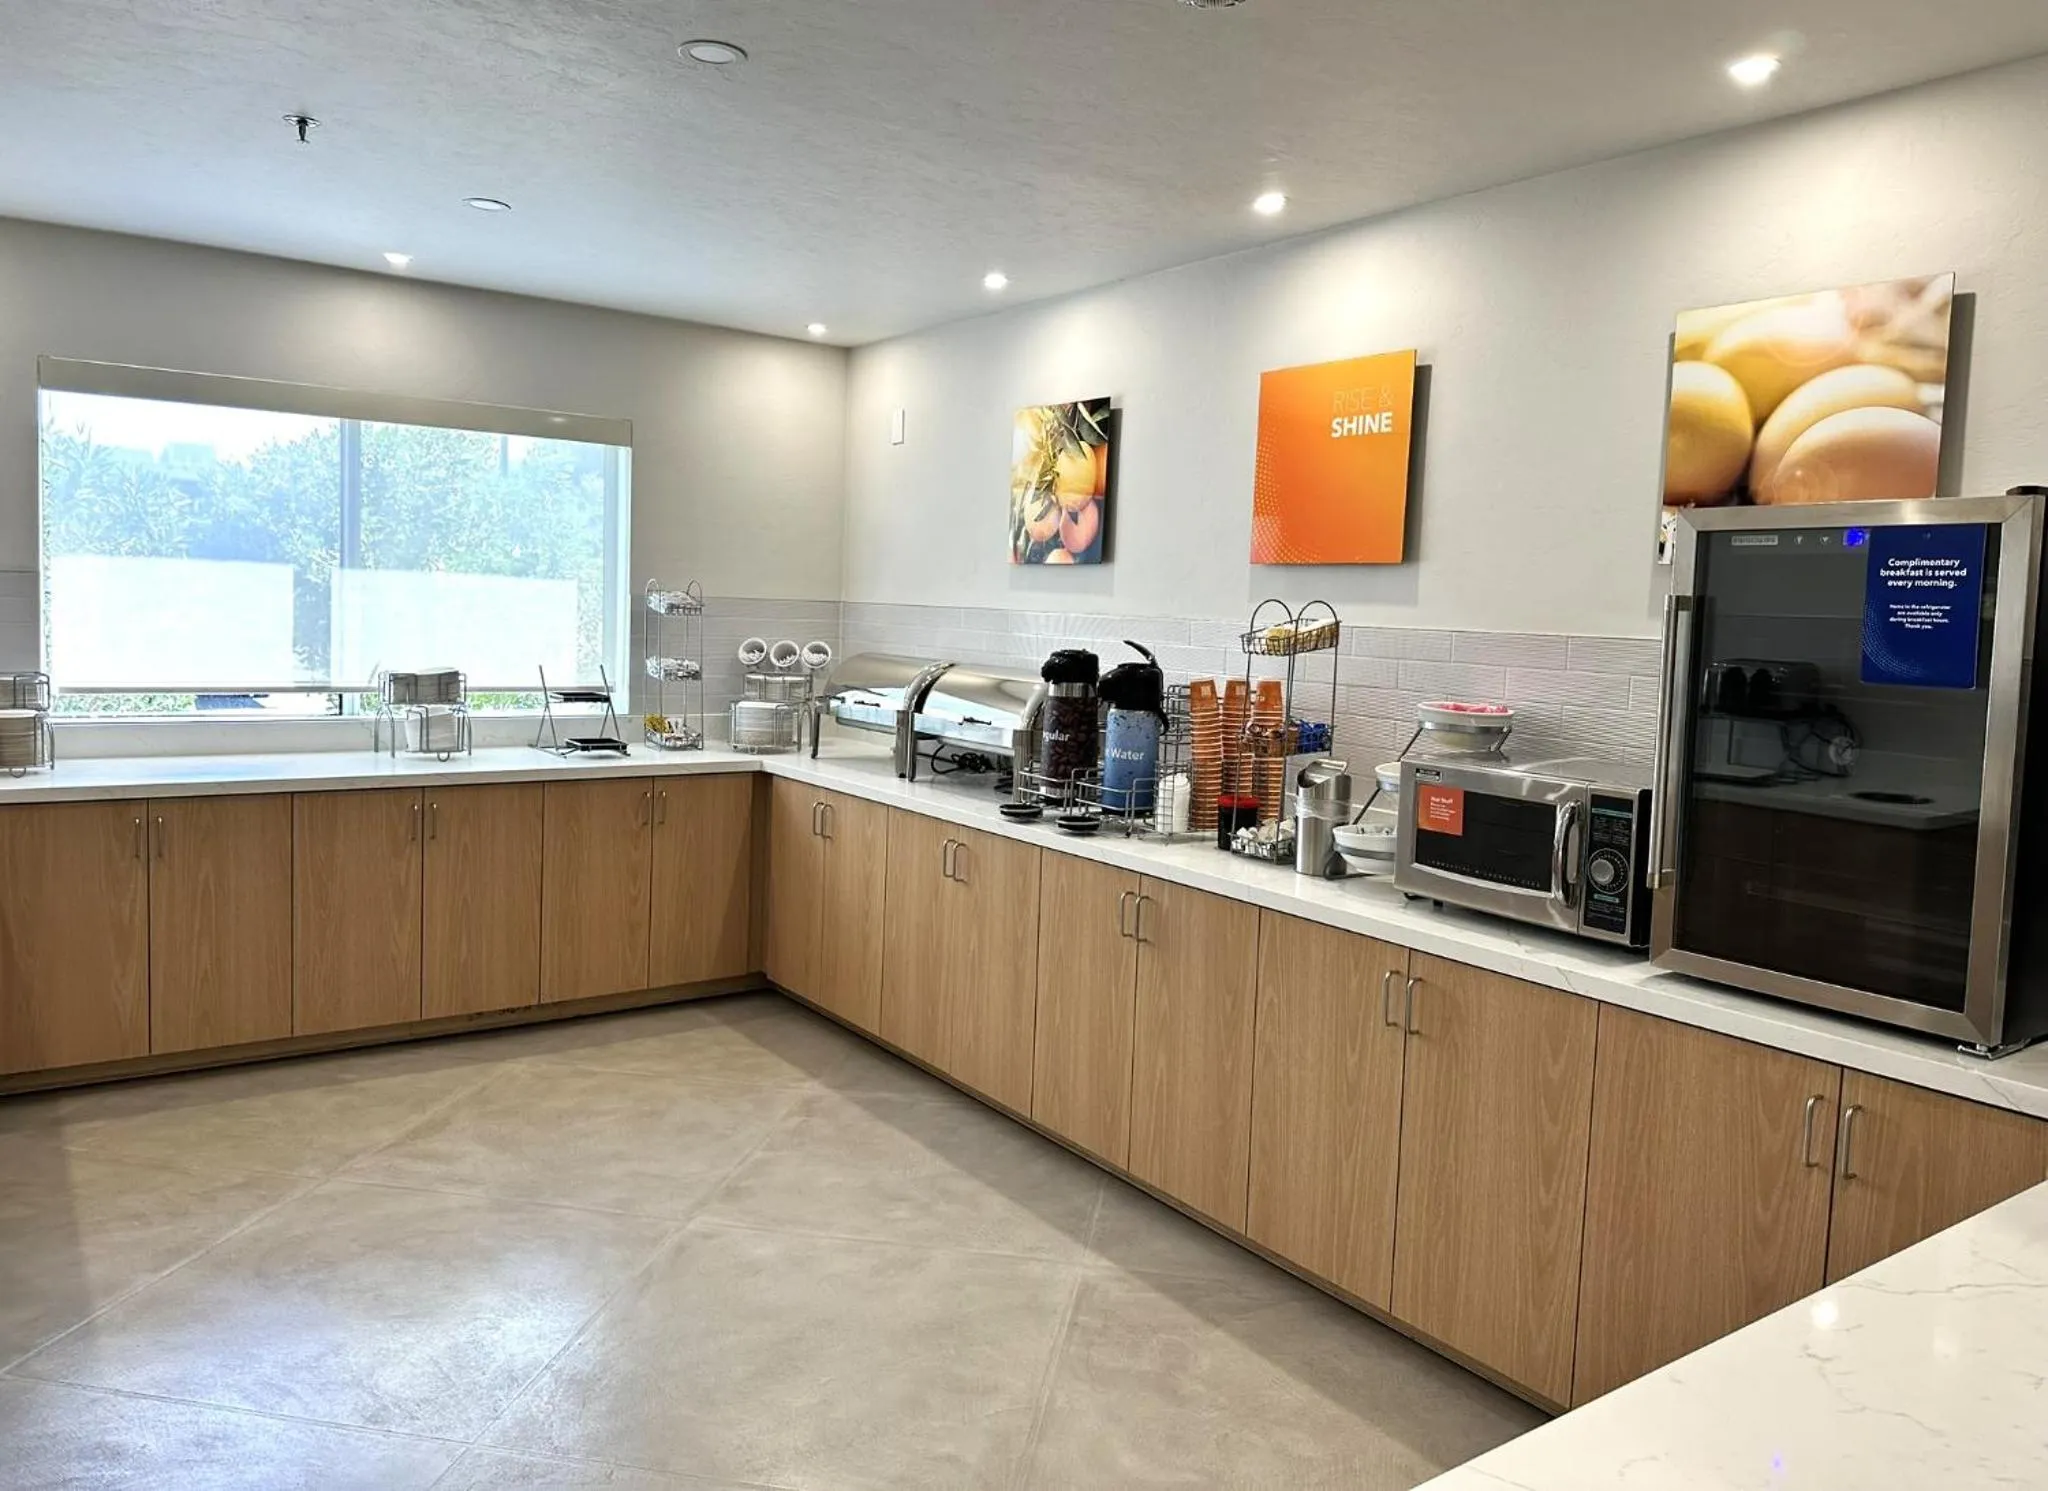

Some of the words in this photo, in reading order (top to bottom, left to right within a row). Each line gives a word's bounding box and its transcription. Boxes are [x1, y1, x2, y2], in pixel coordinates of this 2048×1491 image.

[1333, 388, 1374, 413] RISE
[1379, 385, 1394, 408] &
[1331, 411, 1393, 438] SHINE
[1888, 558, 1960, 568] Complimentary
[1880, 568, 1923, 577] breakfast
[1925, 568, 1933, 577] is
[1934, 568, 1967, 577] served
[1887, 580, 1913, 589] every
[1915, 579, 1958, 589] morning.
[1110, 748, 1145, 760] Water
